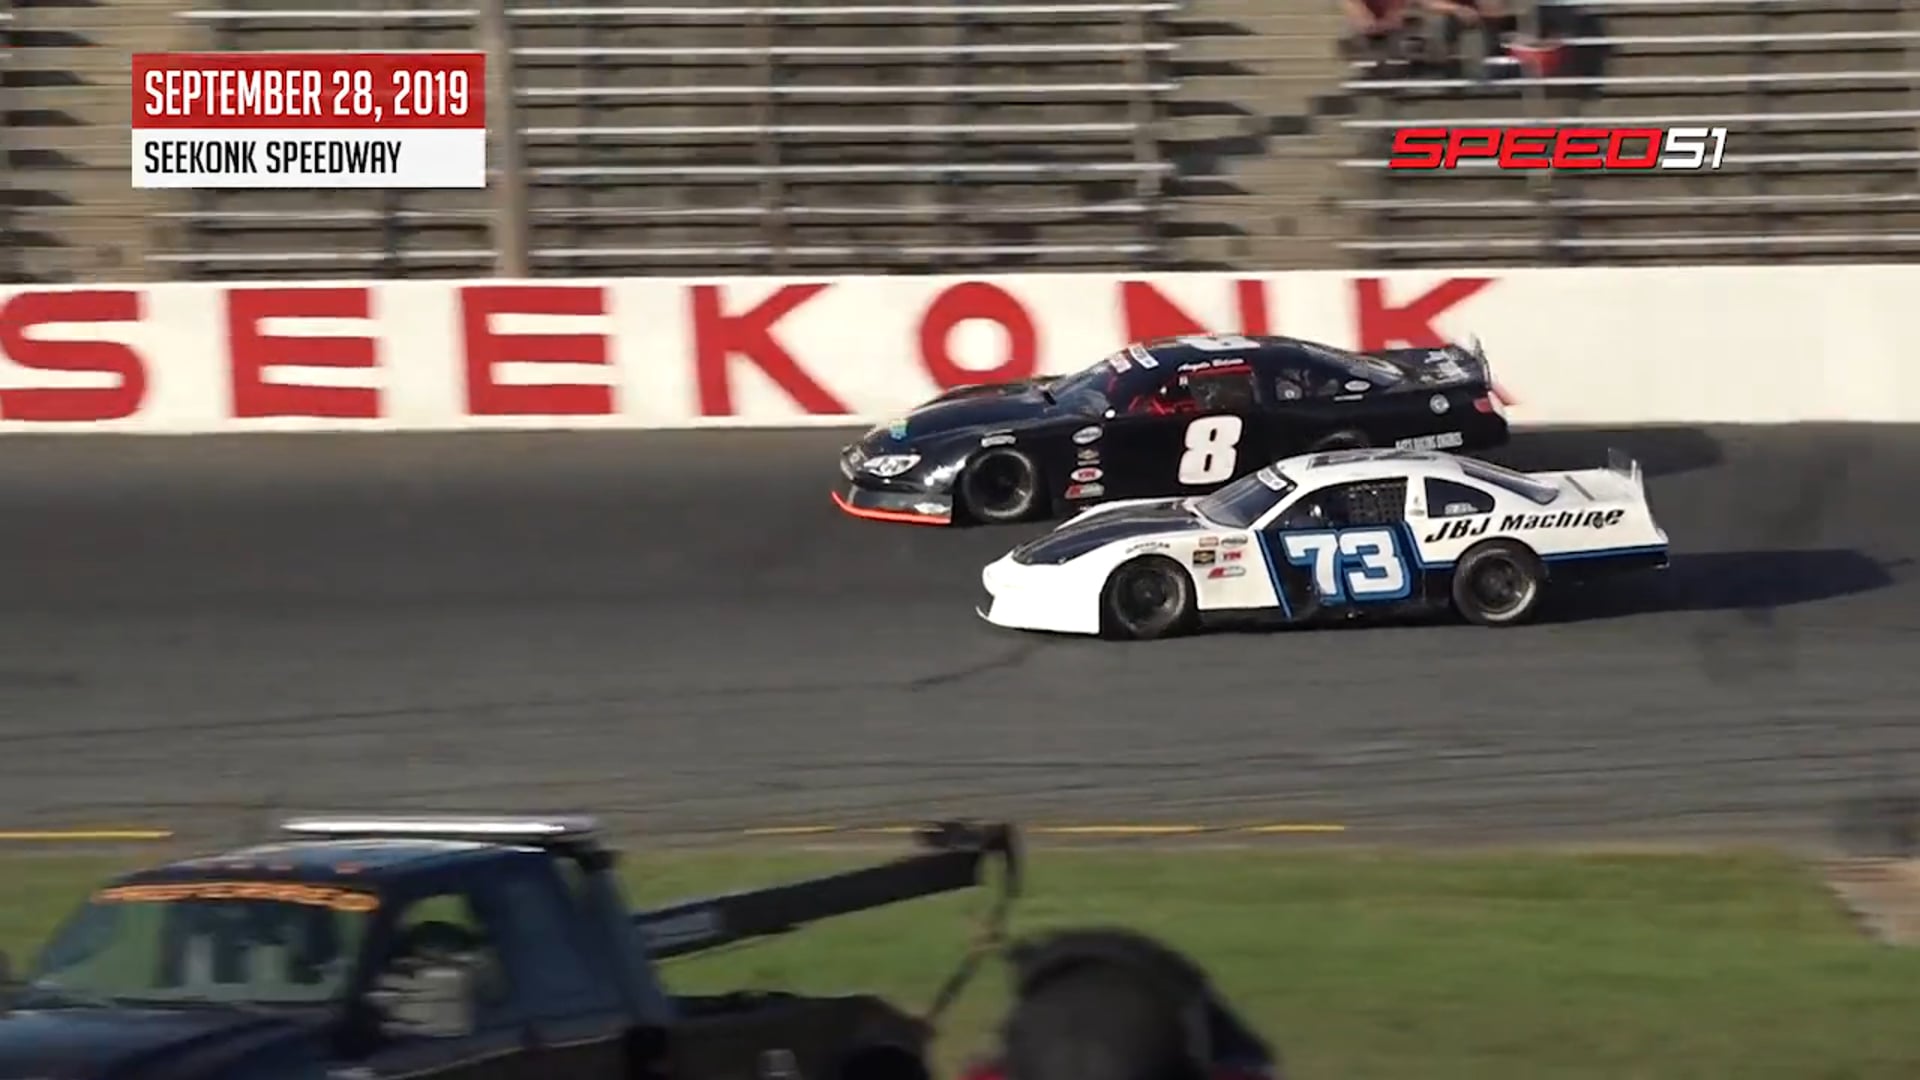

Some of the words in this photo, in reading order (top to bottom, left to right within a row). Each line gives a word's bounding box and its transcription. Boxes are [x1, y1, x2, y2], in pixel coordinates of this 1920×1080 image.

[1178, 414, 1243, 485] 8
[1424, 517, 1491, 544] JBJ
[1500, 508, 1625, 532] Machine
[1280, 527, 1409, 602] 73
